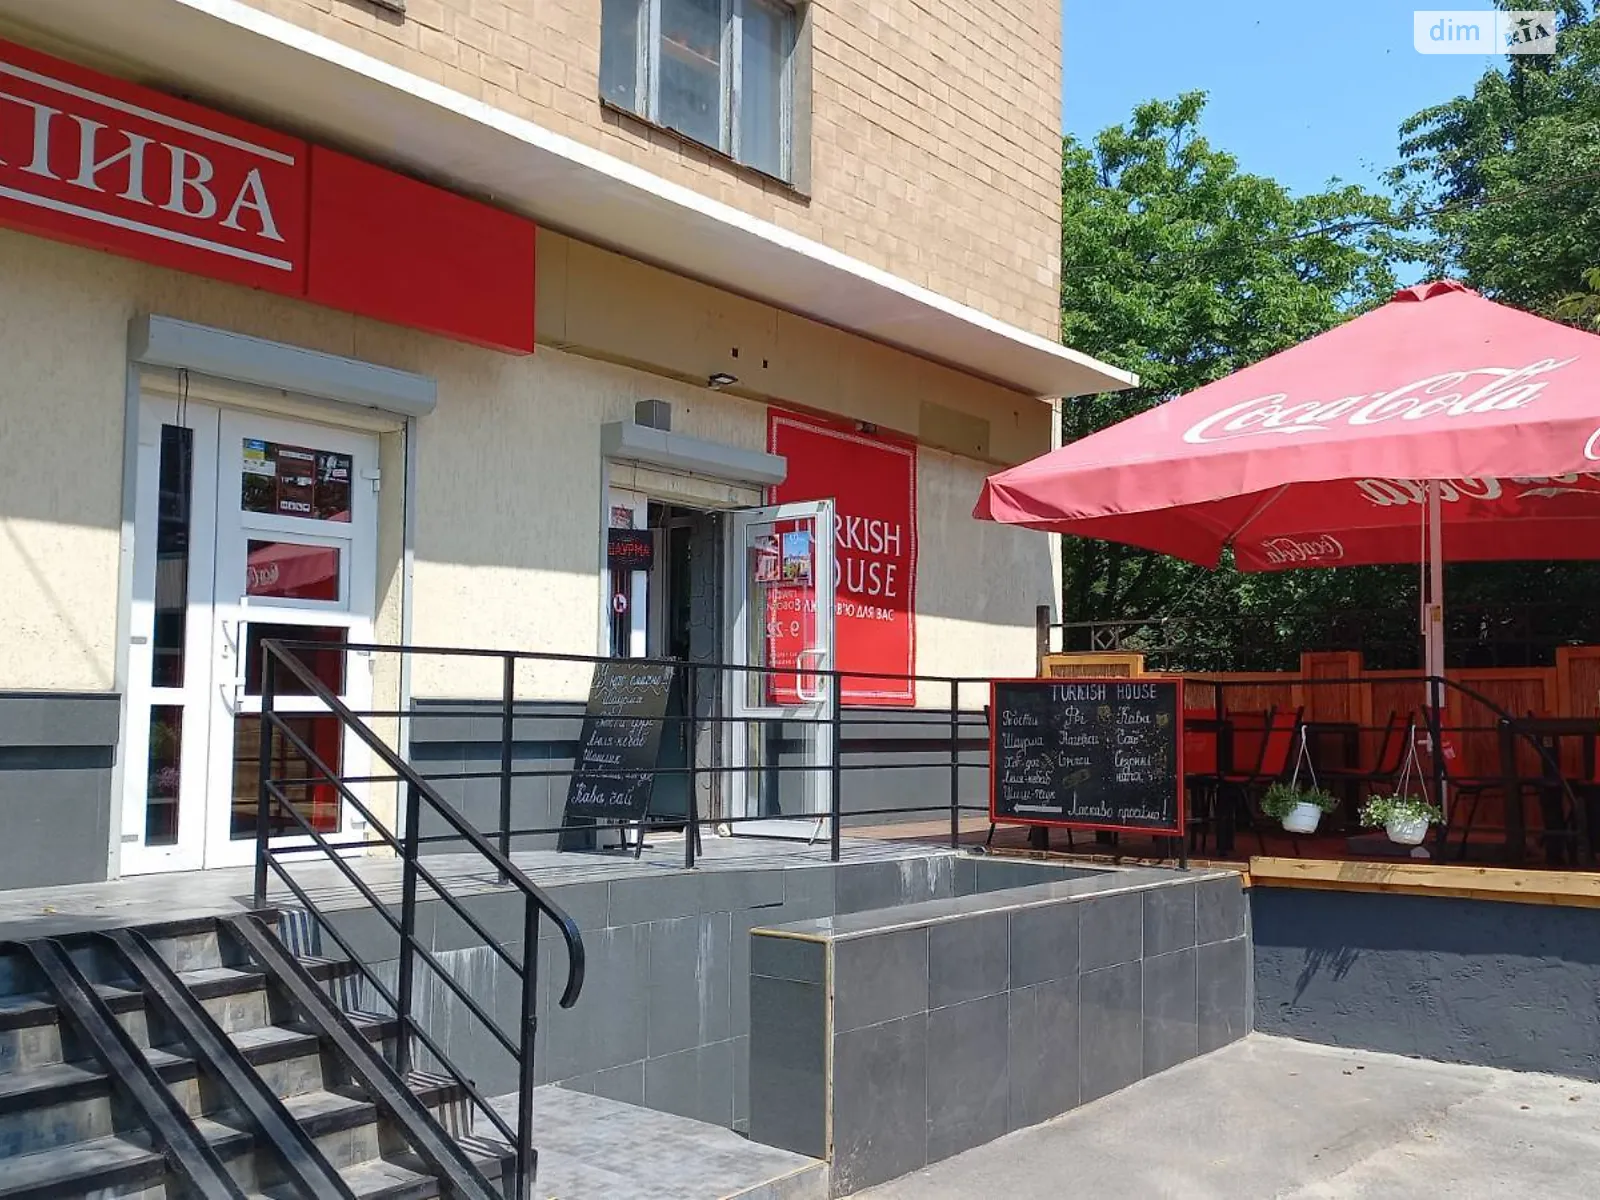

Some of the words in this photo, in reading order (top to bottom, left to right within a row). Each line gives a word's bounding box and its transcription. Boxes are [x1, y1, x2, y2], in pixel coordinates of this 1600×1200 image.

[856, 606, 875, 620] ДЛЯ
[876, 608, 895, 622] ВАС
[1049, 684, 1106, 701] TURKISH
[1117, 684, 1157, 700] HOUSE
